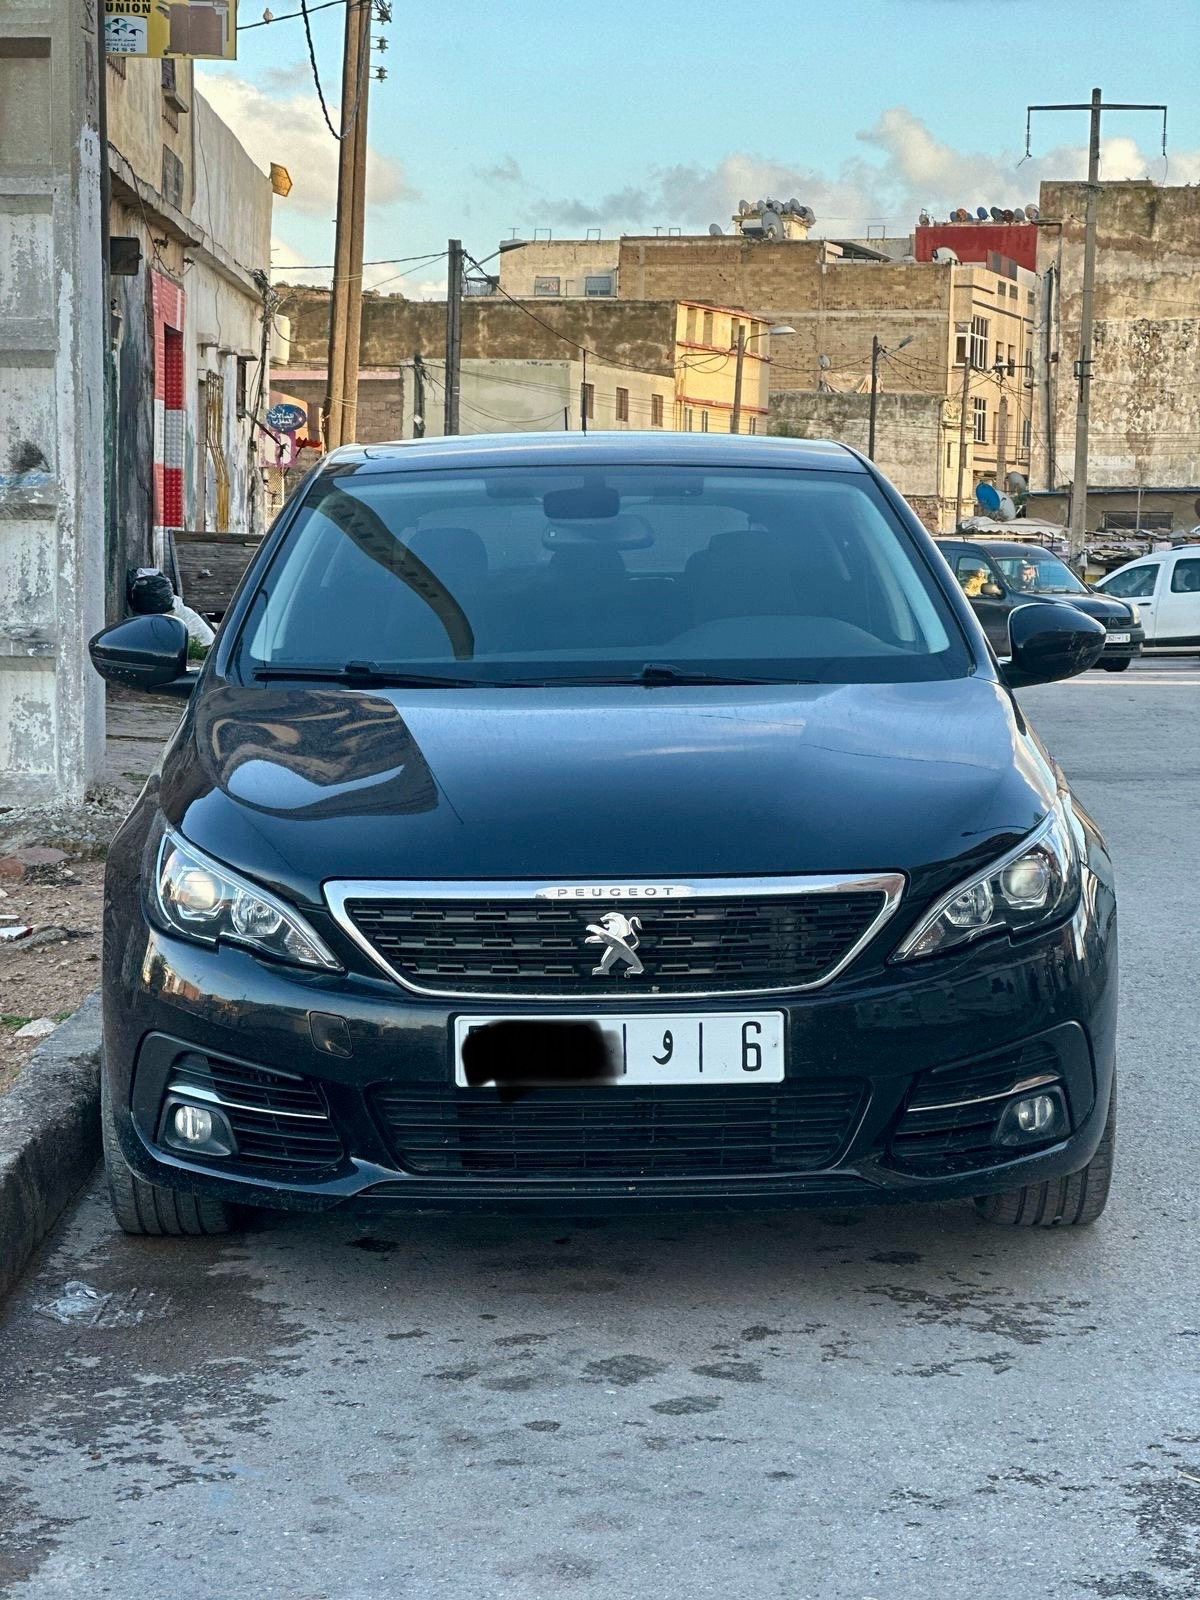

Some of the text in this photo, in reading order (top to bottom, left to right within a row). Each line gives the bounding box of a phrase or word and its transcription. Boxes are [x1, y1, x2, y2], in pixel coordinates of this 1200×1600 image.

[105, 3, 151, 13] UNION
[557, 887, 674, 897] PEUGEOT
[652, 1021, 762, 1072] و 6
